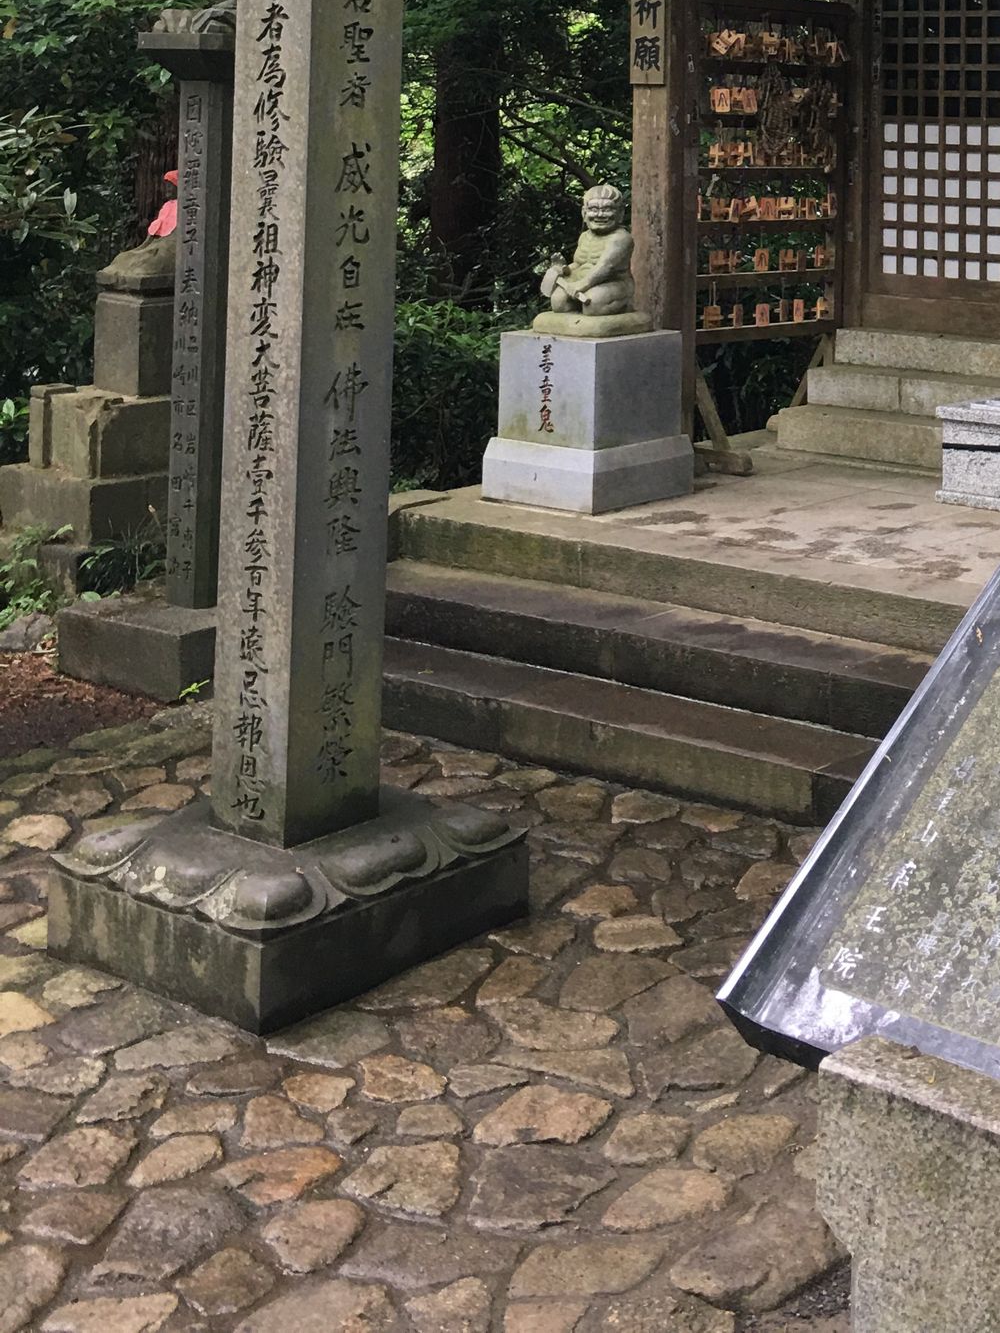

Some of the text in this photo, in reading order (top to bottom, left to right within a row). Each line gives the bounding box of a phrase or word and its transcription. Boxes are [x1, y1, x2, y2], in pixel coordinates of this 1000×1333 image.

[334, 140, 373, 332] 威光自在
[538, 343, 554, 434] 善童鬼
